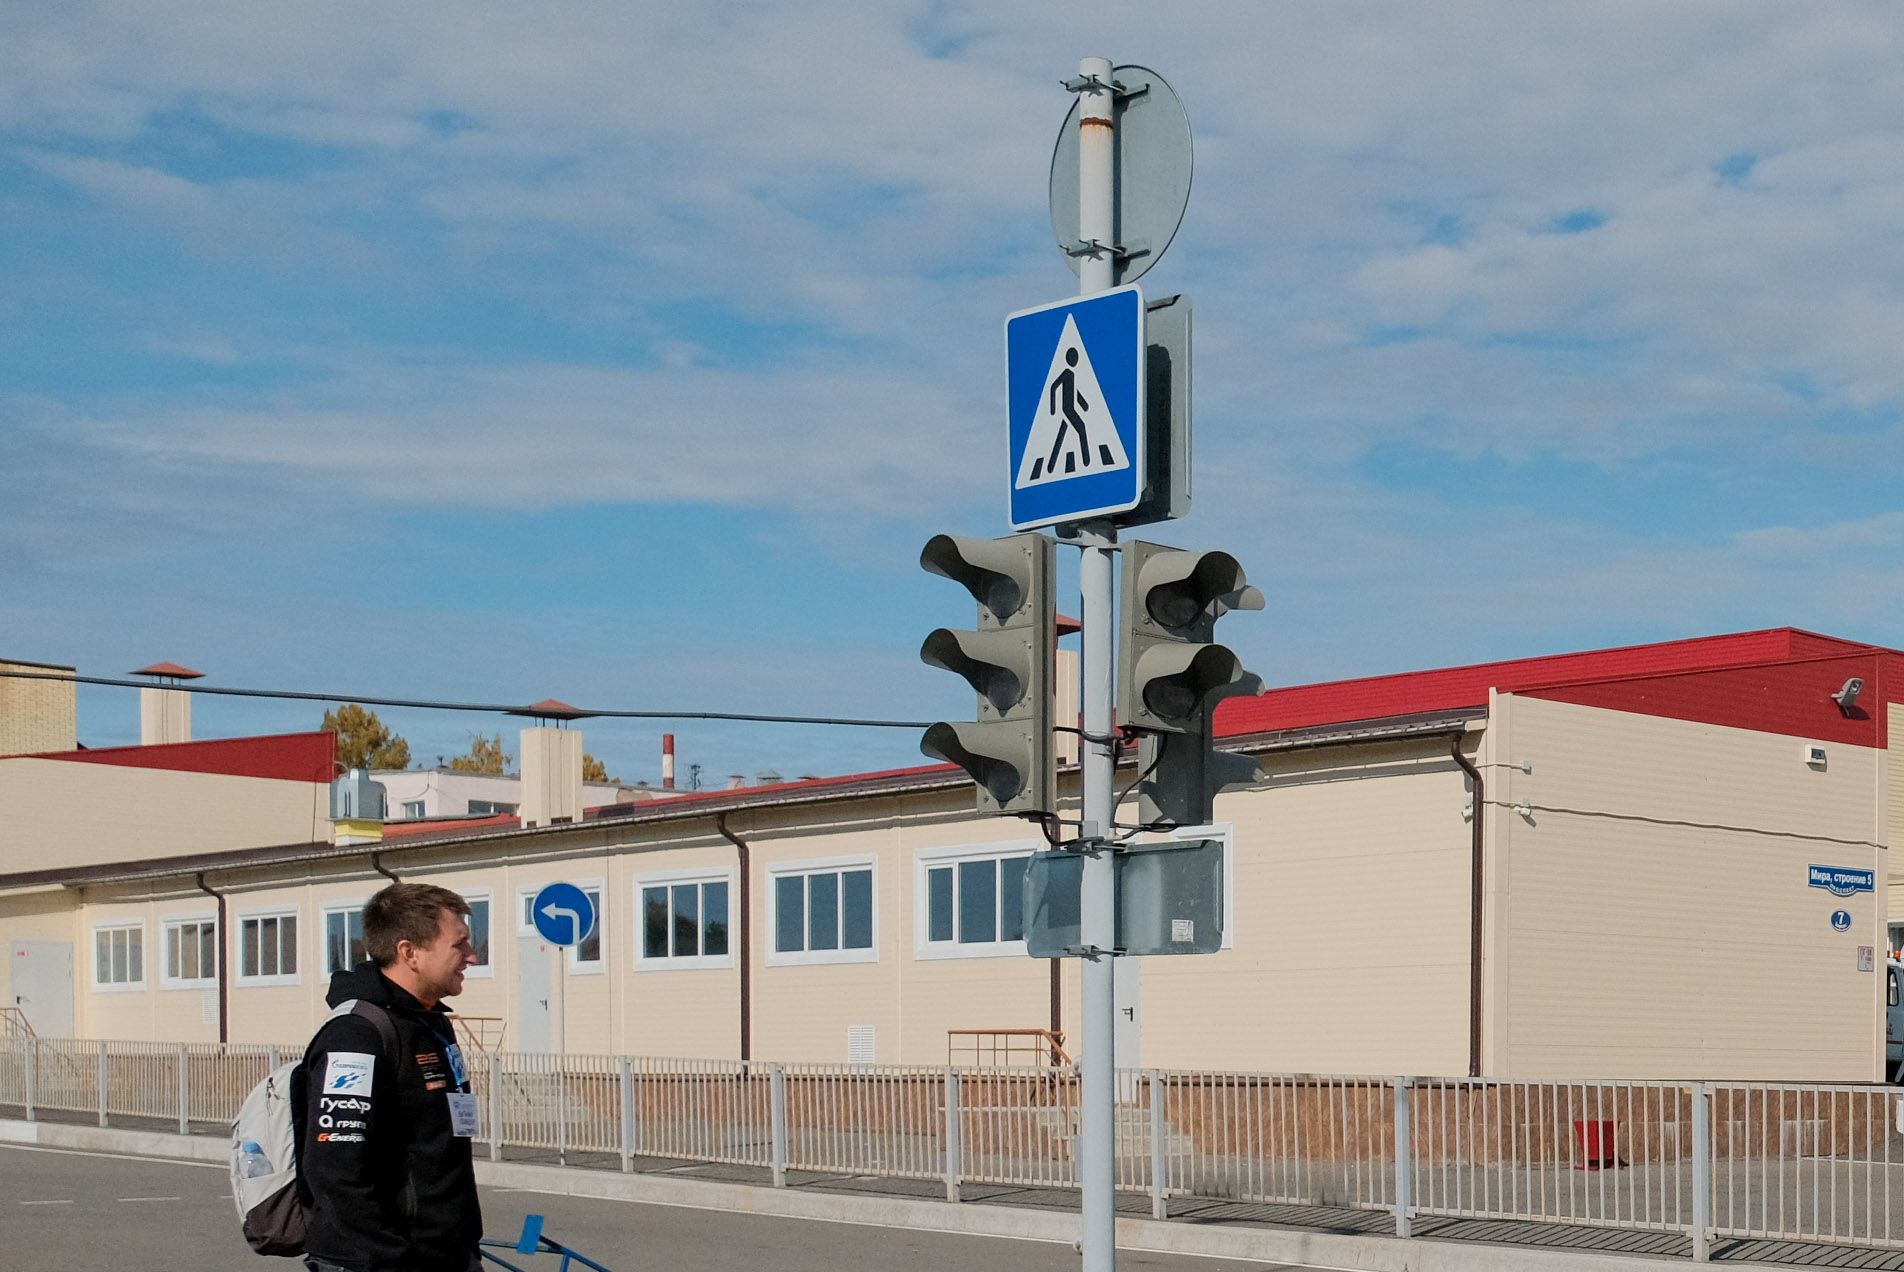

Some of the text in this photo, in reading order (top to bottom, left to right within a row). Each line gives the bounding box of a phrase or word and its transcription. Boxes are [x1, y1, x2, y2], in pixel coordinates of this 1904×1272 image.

[1810, 868, 1832, 883] Мира,
[1834, 873, 1866, 885] строение
[1837, 911, 1844, 924] 7
